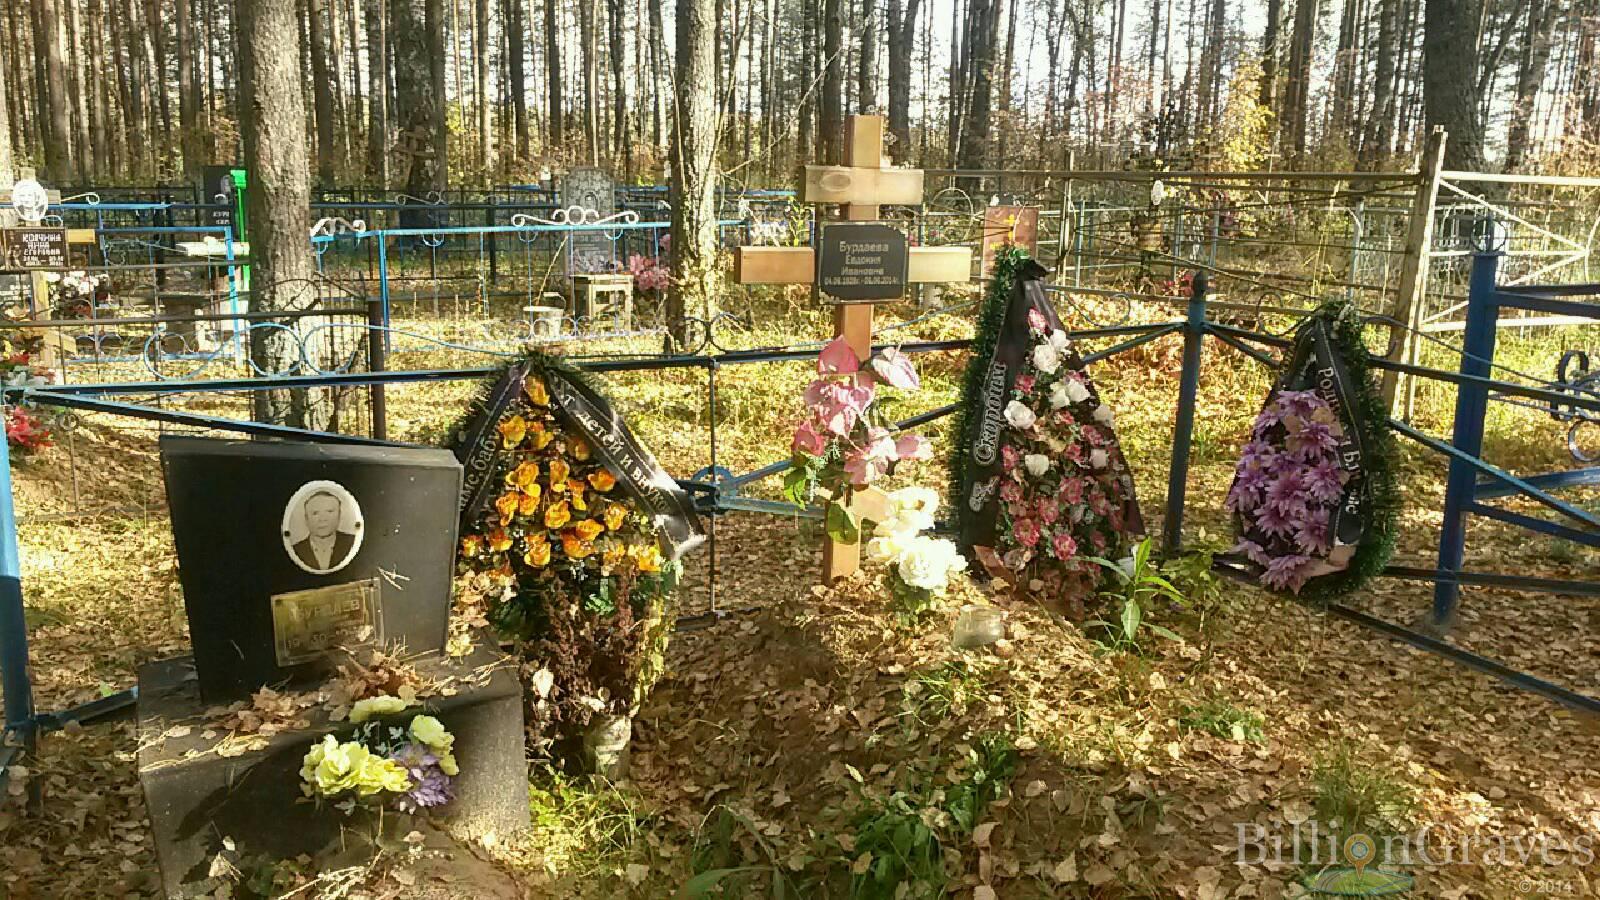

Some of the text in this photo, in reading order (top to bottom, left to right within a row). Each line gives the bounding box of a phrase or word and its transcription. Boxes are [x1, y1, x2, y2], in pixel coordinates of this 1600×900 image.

[839, 241, 889, 254] Бурдаева
[845, 254, 882, 265] Евдокия
[841, 266, 885, 275] Ивановна
[972, 362, 1007, 466] Скорбим
[576, 412, 624, 456] детей
[619, 456, 635, 471] и
